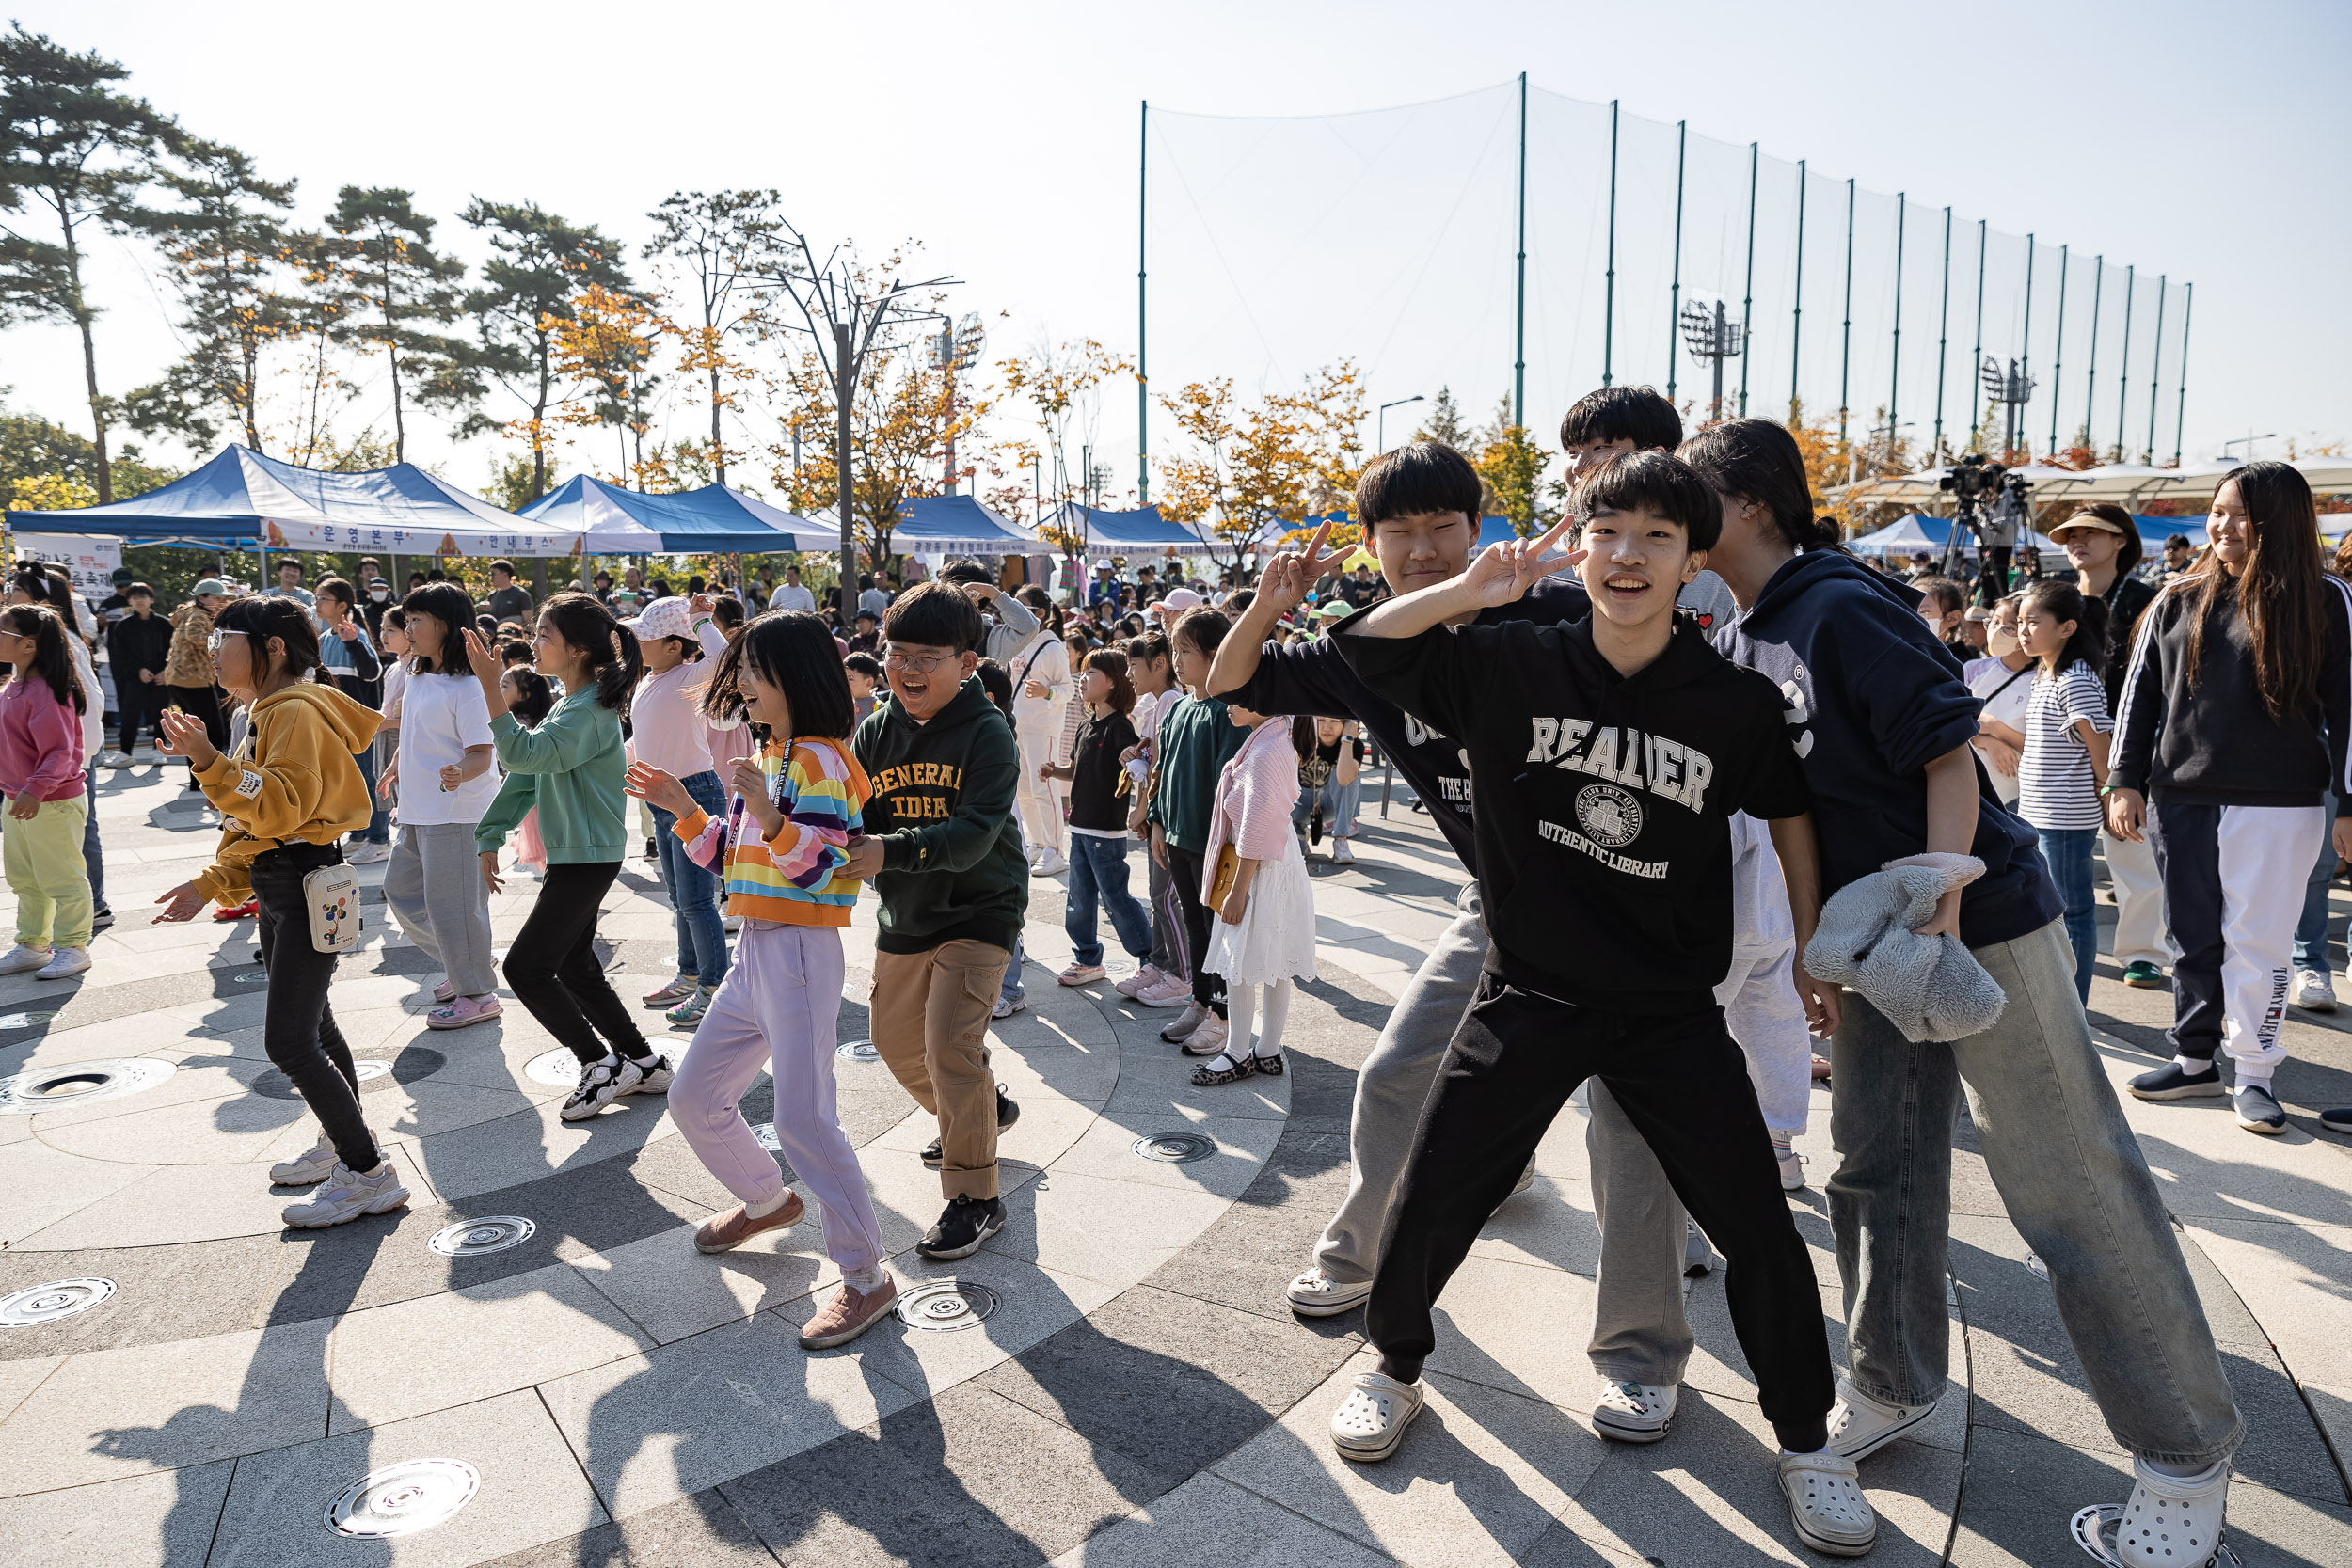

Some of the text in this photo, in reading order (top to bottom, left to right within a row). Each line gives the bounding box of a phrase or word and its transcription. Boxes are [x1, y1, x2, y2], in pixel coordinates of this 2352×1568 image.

[324, 525, 404, 546] 운영본부
[489, 534, 549, 548] 안내부스
[1438, 776, 1463, 800] THE
[1583, 786, 1600, 799] CLUB
[890, 796, 950, 818] IDEA
[1538, 819, 1669, 879] AUTHENTIC LIBRARY
[2270, 966, 2288, 1006] TOMMY
